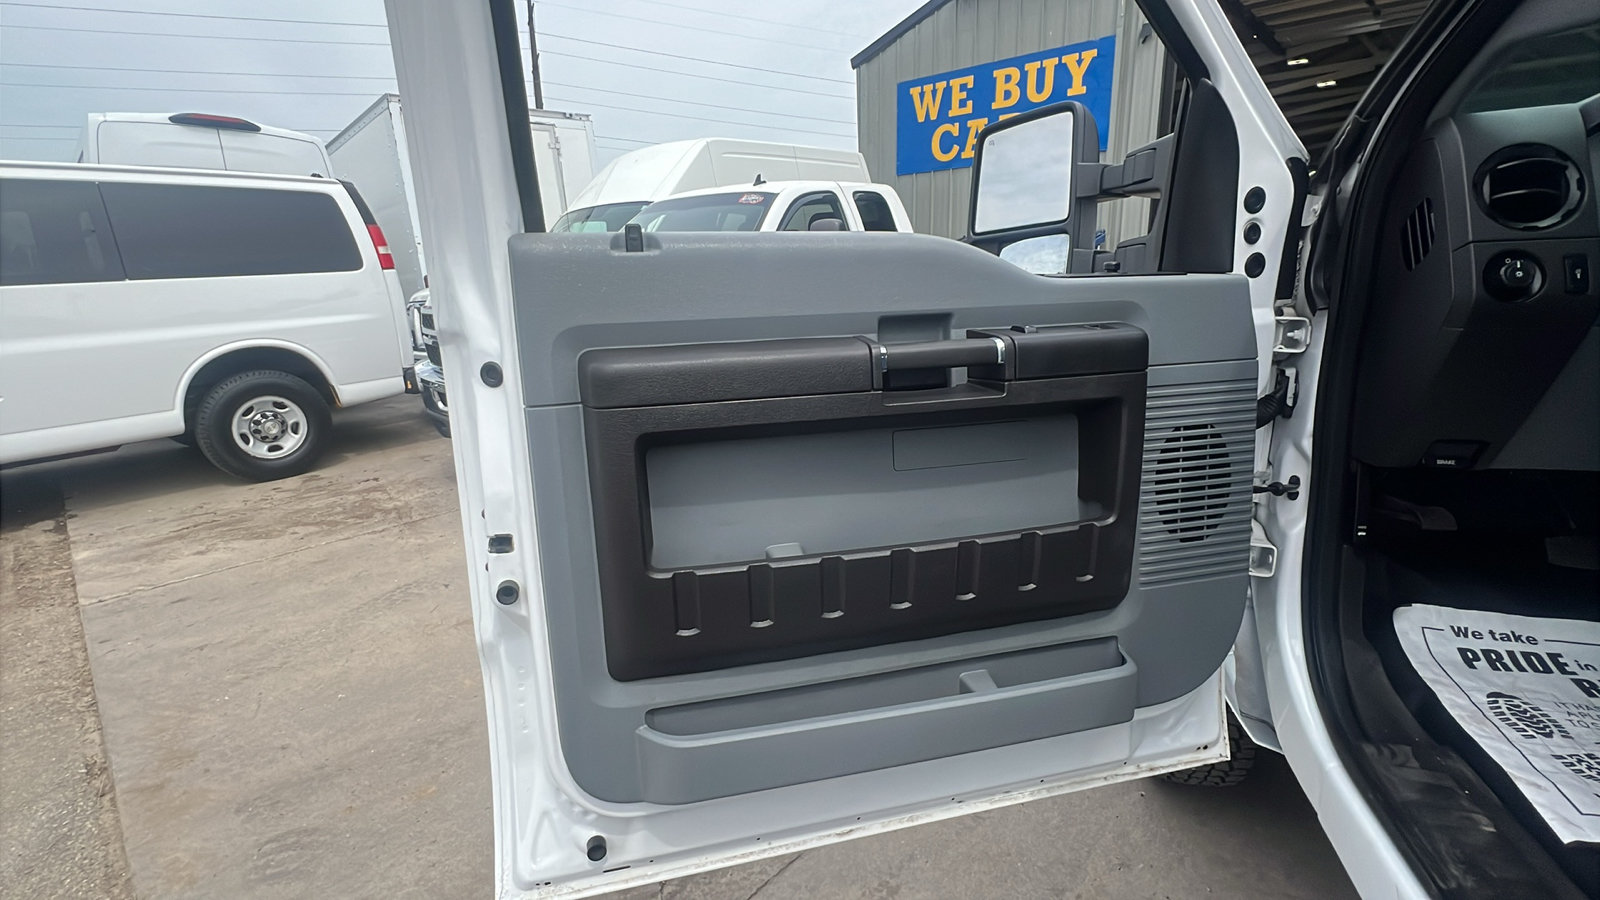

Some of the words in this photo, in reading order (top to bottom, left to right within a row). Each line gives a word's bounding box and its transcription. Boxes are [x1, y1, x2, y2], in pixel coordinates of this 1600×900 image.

[909, 75, 974, 123] WE
[991, 48, 1098, 110] BUY
[931, 112, 1022, 162] CA
[1449, 625, 1484, 640] We
[1488, 629, 1539, 646] take
[1456, 647, 1579, 676] PRIDE
[1574, 659, 1599, 672] in
